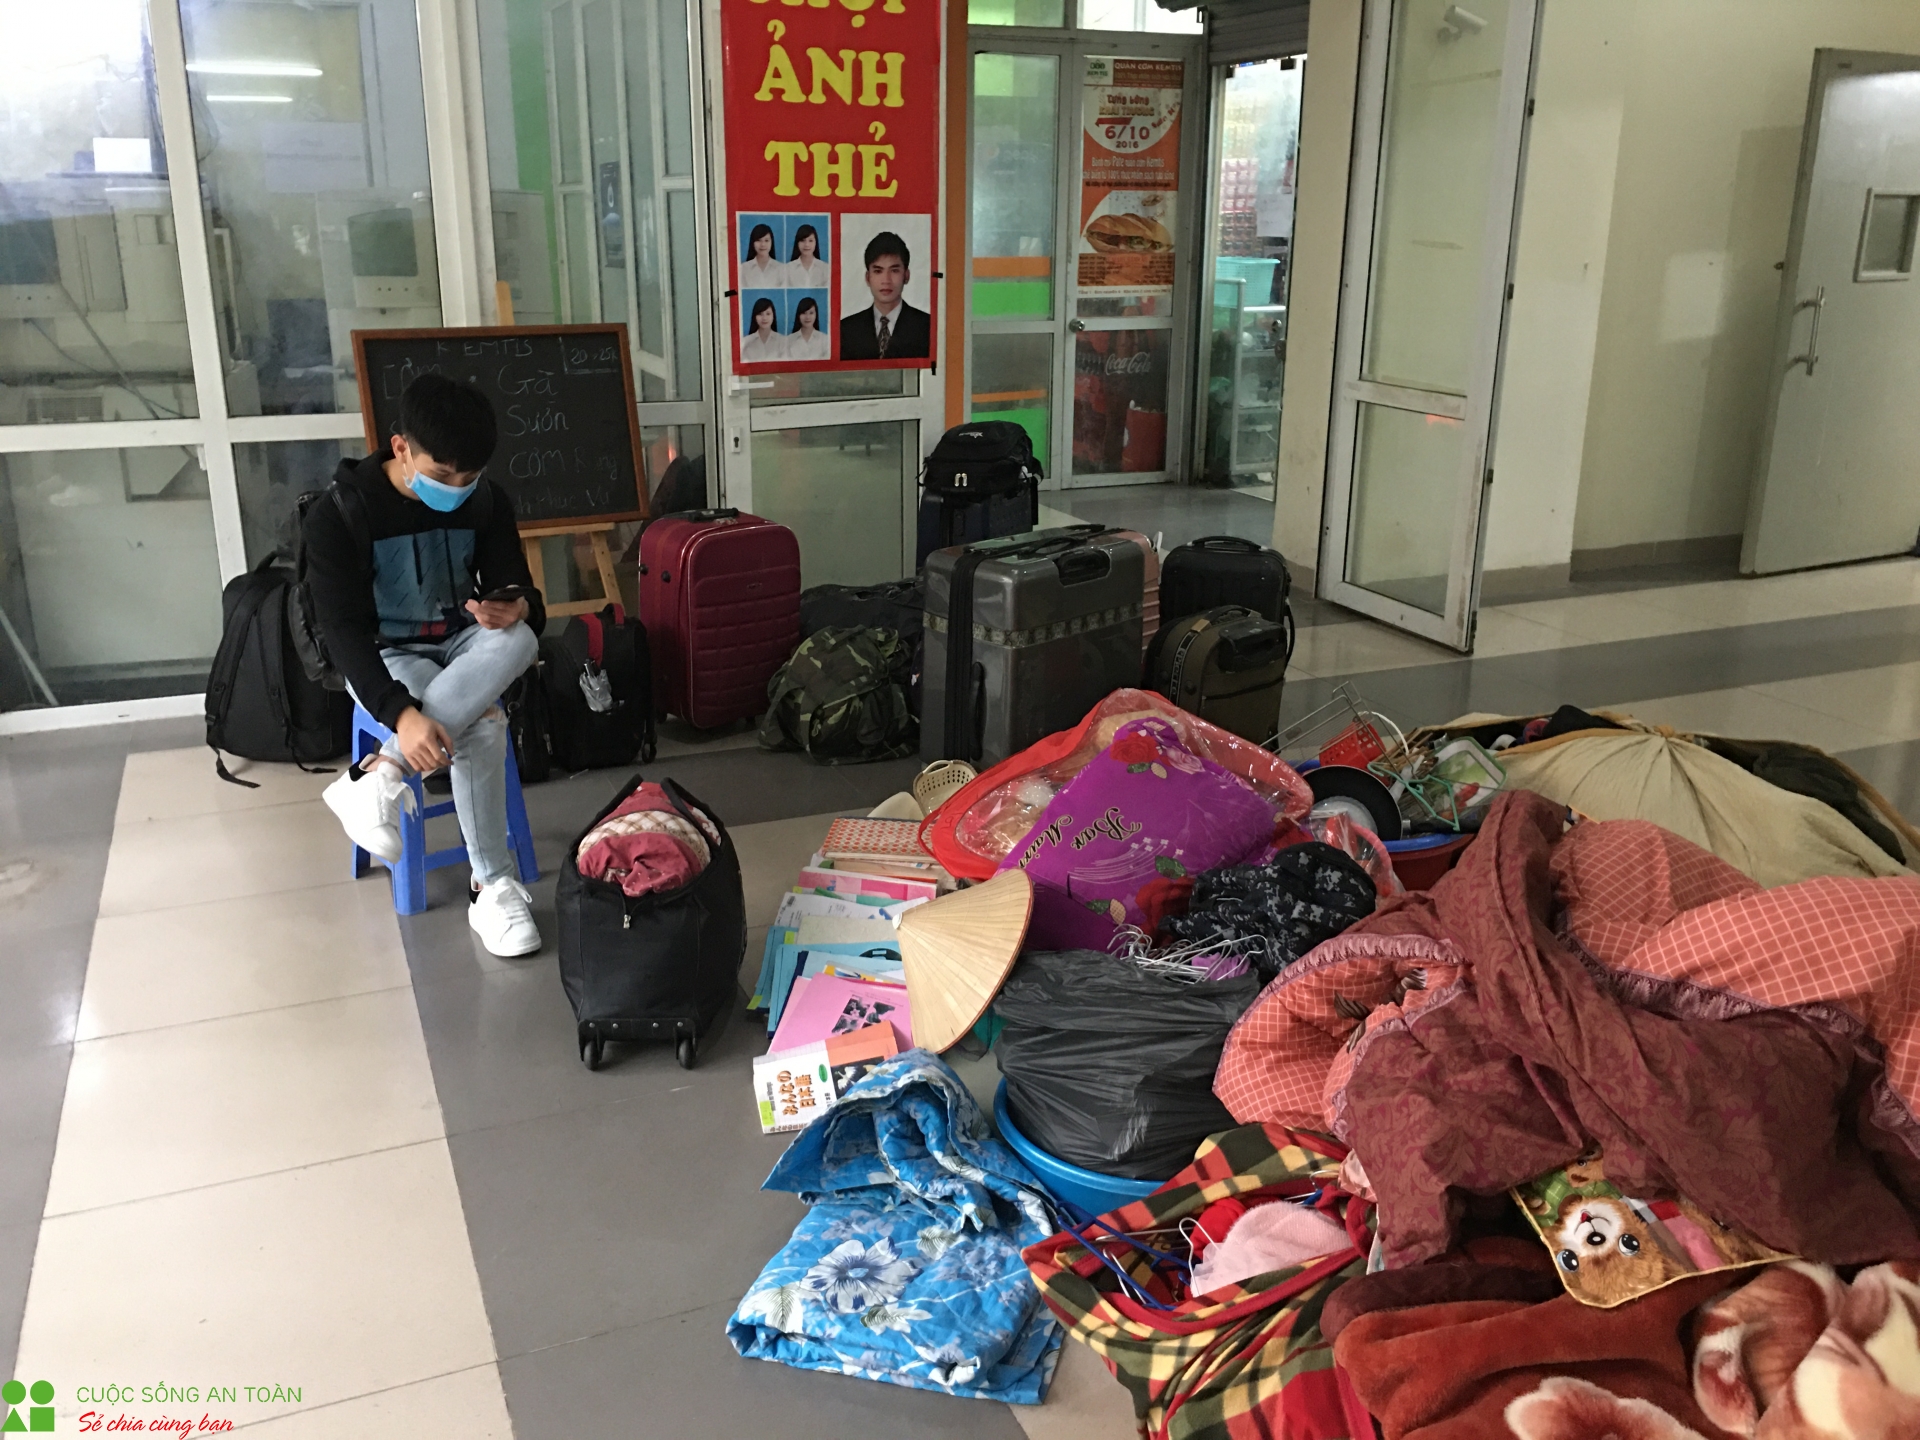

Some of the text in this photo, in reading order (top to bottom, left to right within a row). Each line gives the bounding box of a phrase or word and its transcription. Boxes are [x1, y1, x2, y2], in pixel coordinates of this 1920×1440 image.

[754, 19, 906, 107] ẢNH
[1105, 125, 1150, 140] 6/10
[1115, 140, 1139, 149] 2016
[764, 121, 898, 198] THẺ
[777, 1070, 799, 1116] みんなの
